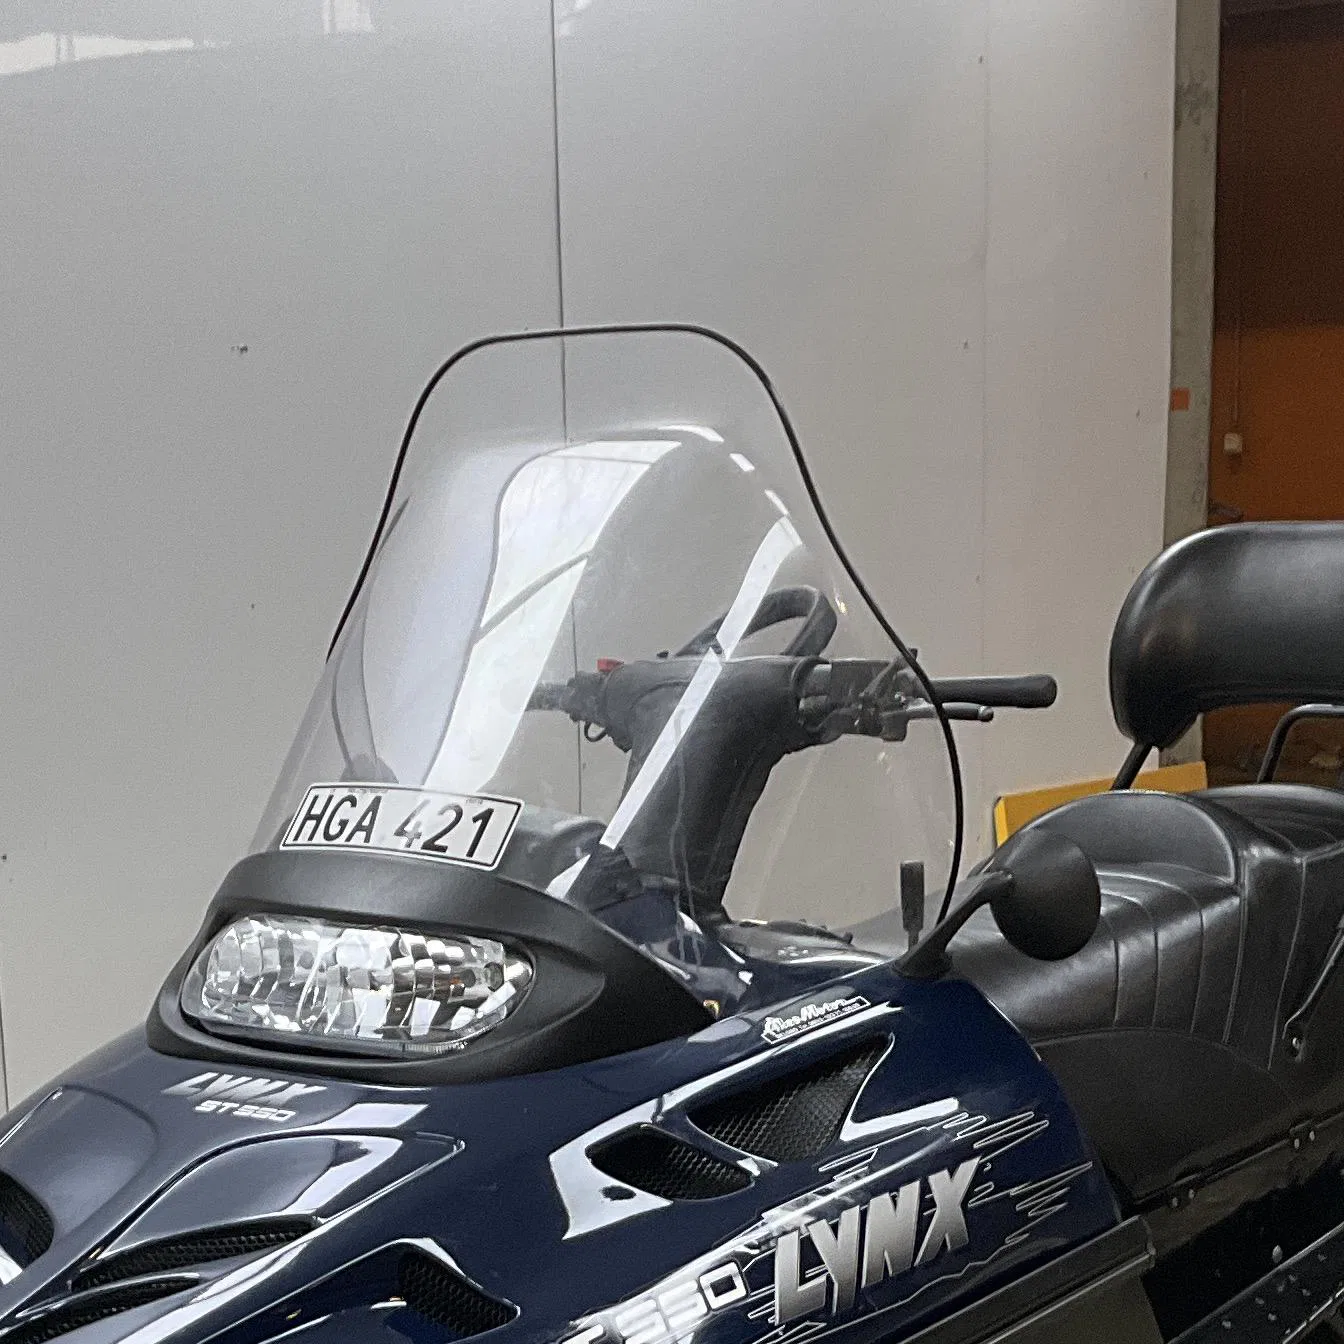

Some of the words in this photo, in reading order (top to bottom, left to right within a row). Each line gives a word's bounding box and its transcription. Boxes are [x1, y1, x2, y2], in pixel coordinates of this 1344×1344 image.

[293, 794, 383, 844] HGA
[393, 799, 494, 858] 421
[160, 1071, 328, 1106] LYNX
[774, 1156, 982, 1326] LYNX
